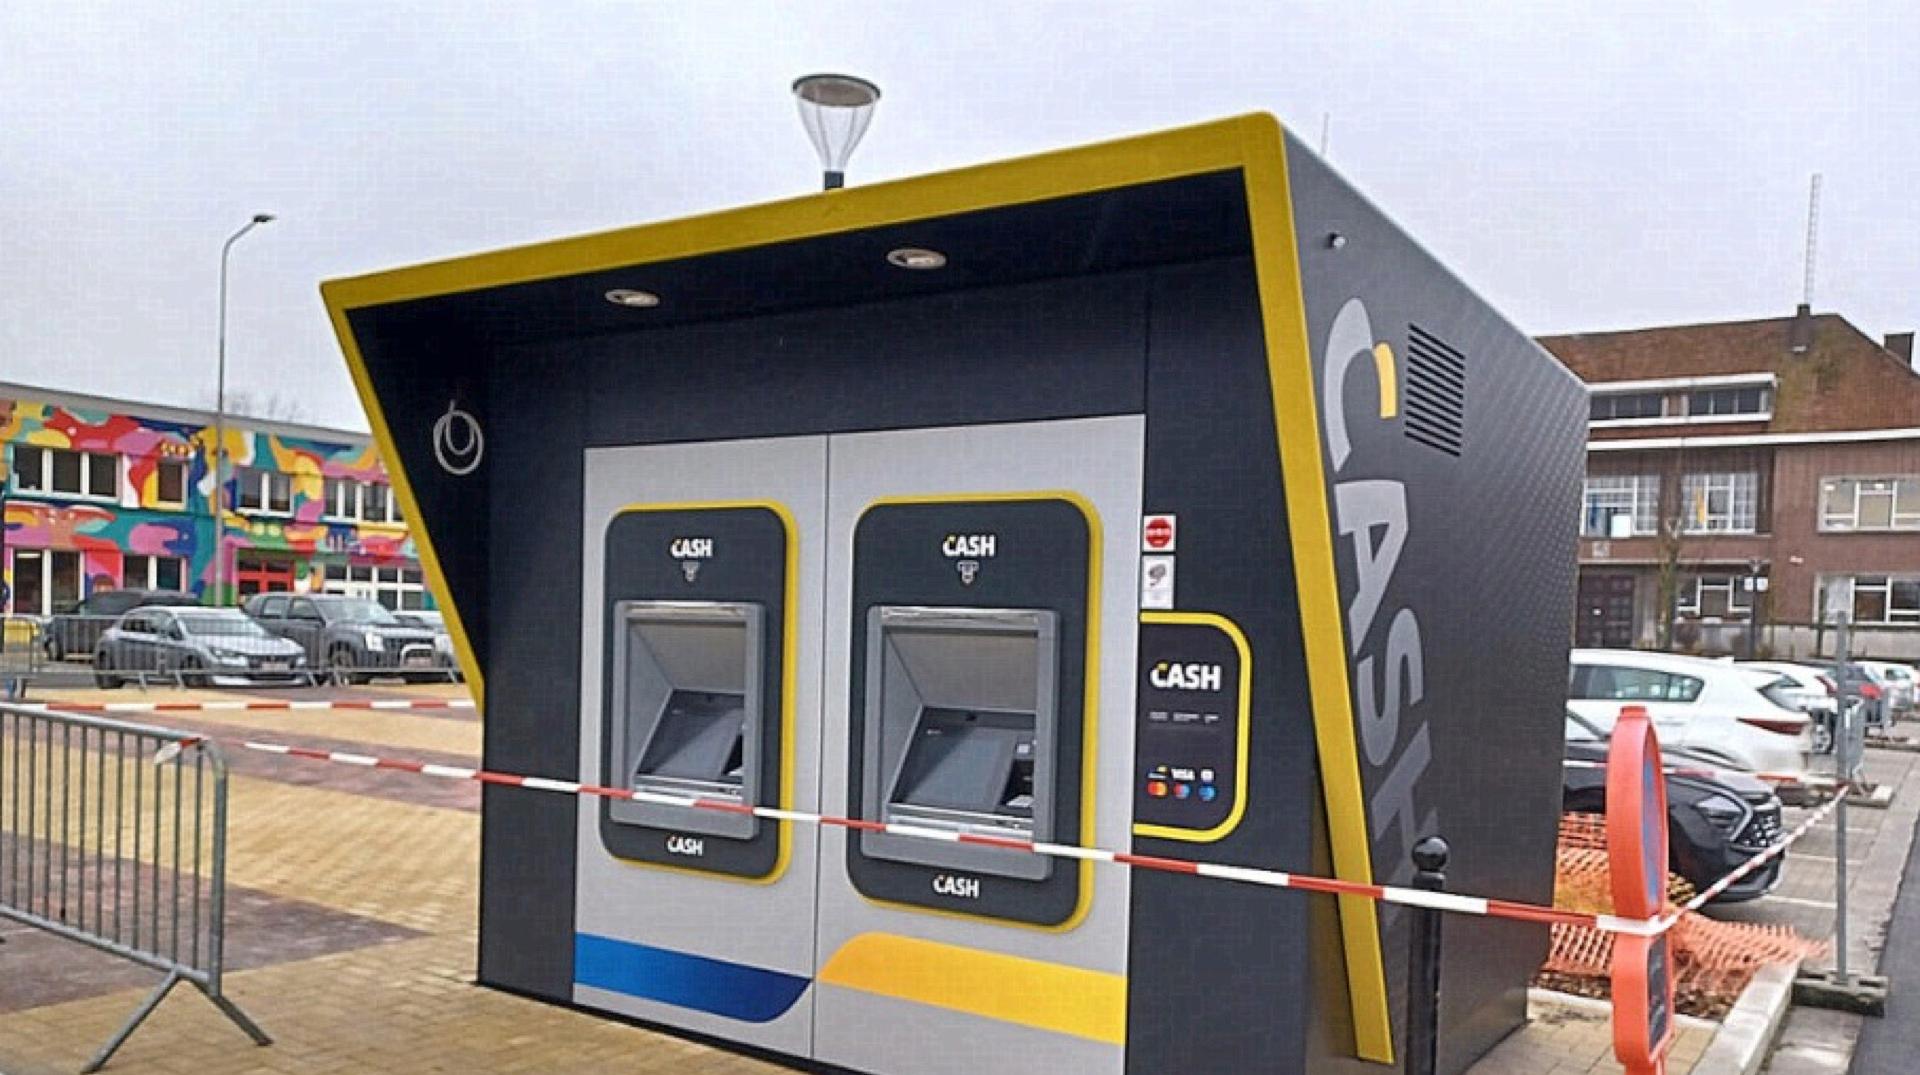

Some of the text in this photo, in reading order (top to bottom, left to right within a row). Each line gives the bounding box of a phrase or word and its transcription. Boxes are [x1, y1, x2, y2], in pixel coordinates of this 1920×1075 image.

[672, 538, 713, 558] CASH
[943, 535, 995, 557] CASH
[1324, 298, 1438, 928] CASH
[1149, 663, 1221, 691] CASH
[668, 836, 703, 856] CASH
[933, 875, 980, 898] CASH
